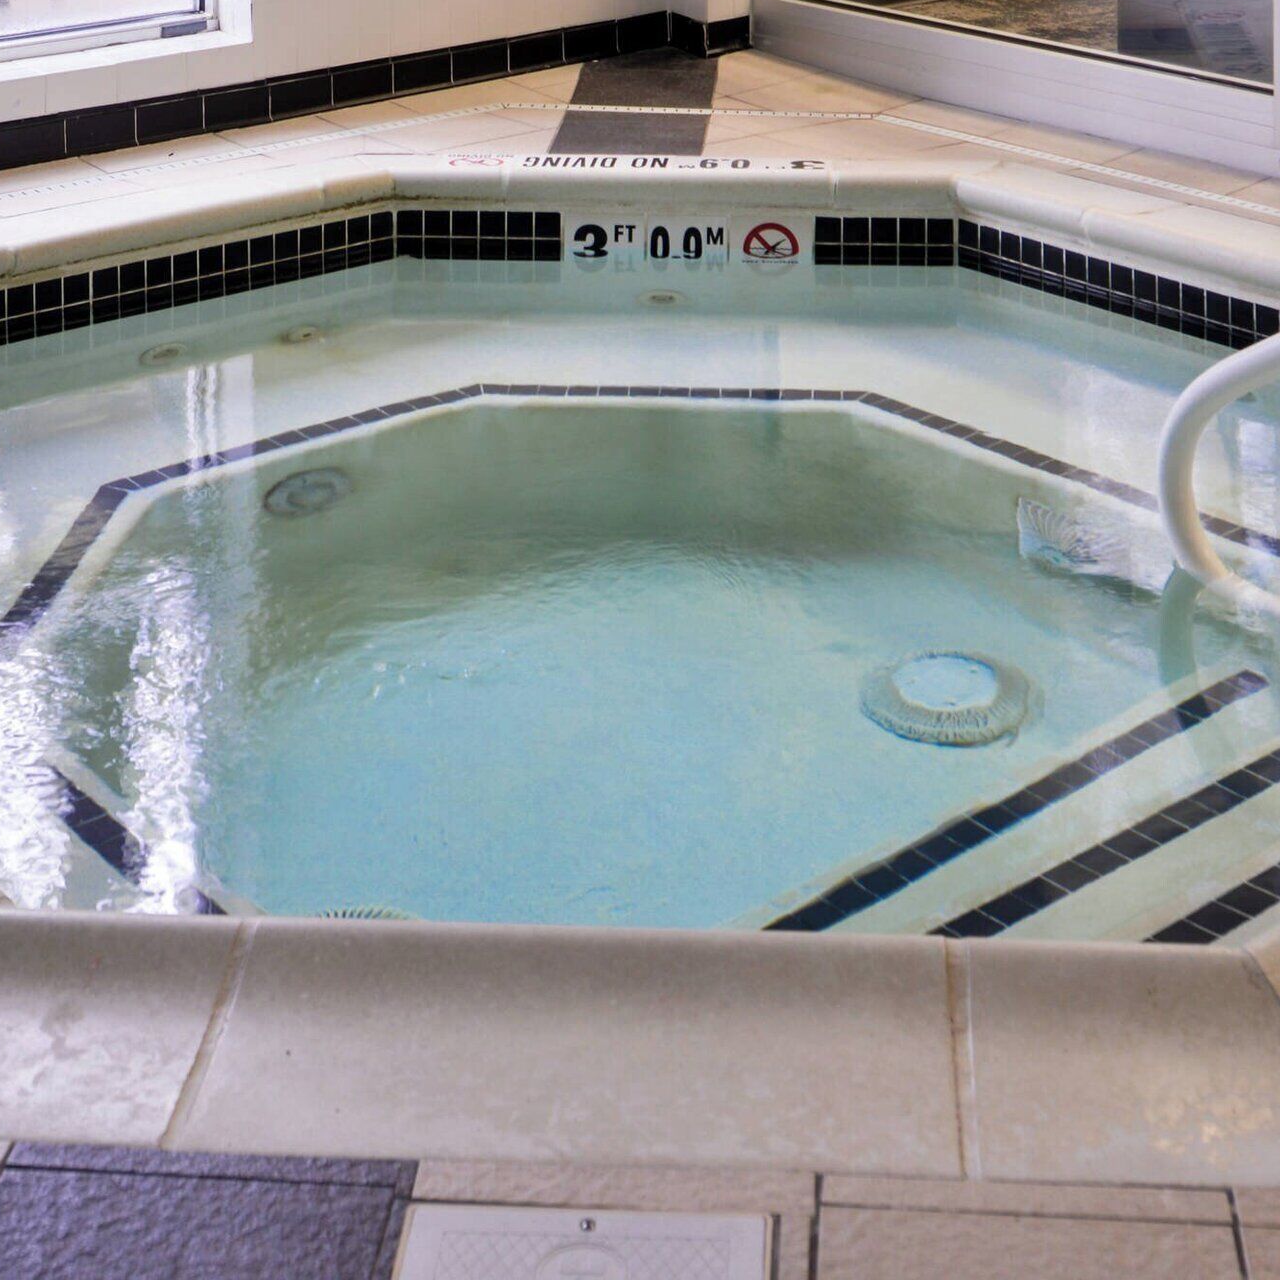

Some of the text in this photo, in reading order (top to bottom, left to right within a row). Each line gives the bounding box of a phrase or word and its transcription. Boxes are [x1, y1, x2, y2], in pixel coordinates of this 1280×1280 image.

[522, 156, 618, 168] DIVING
[631, 157, 670, 169] NO
[614, 224, 636, 243] FT
